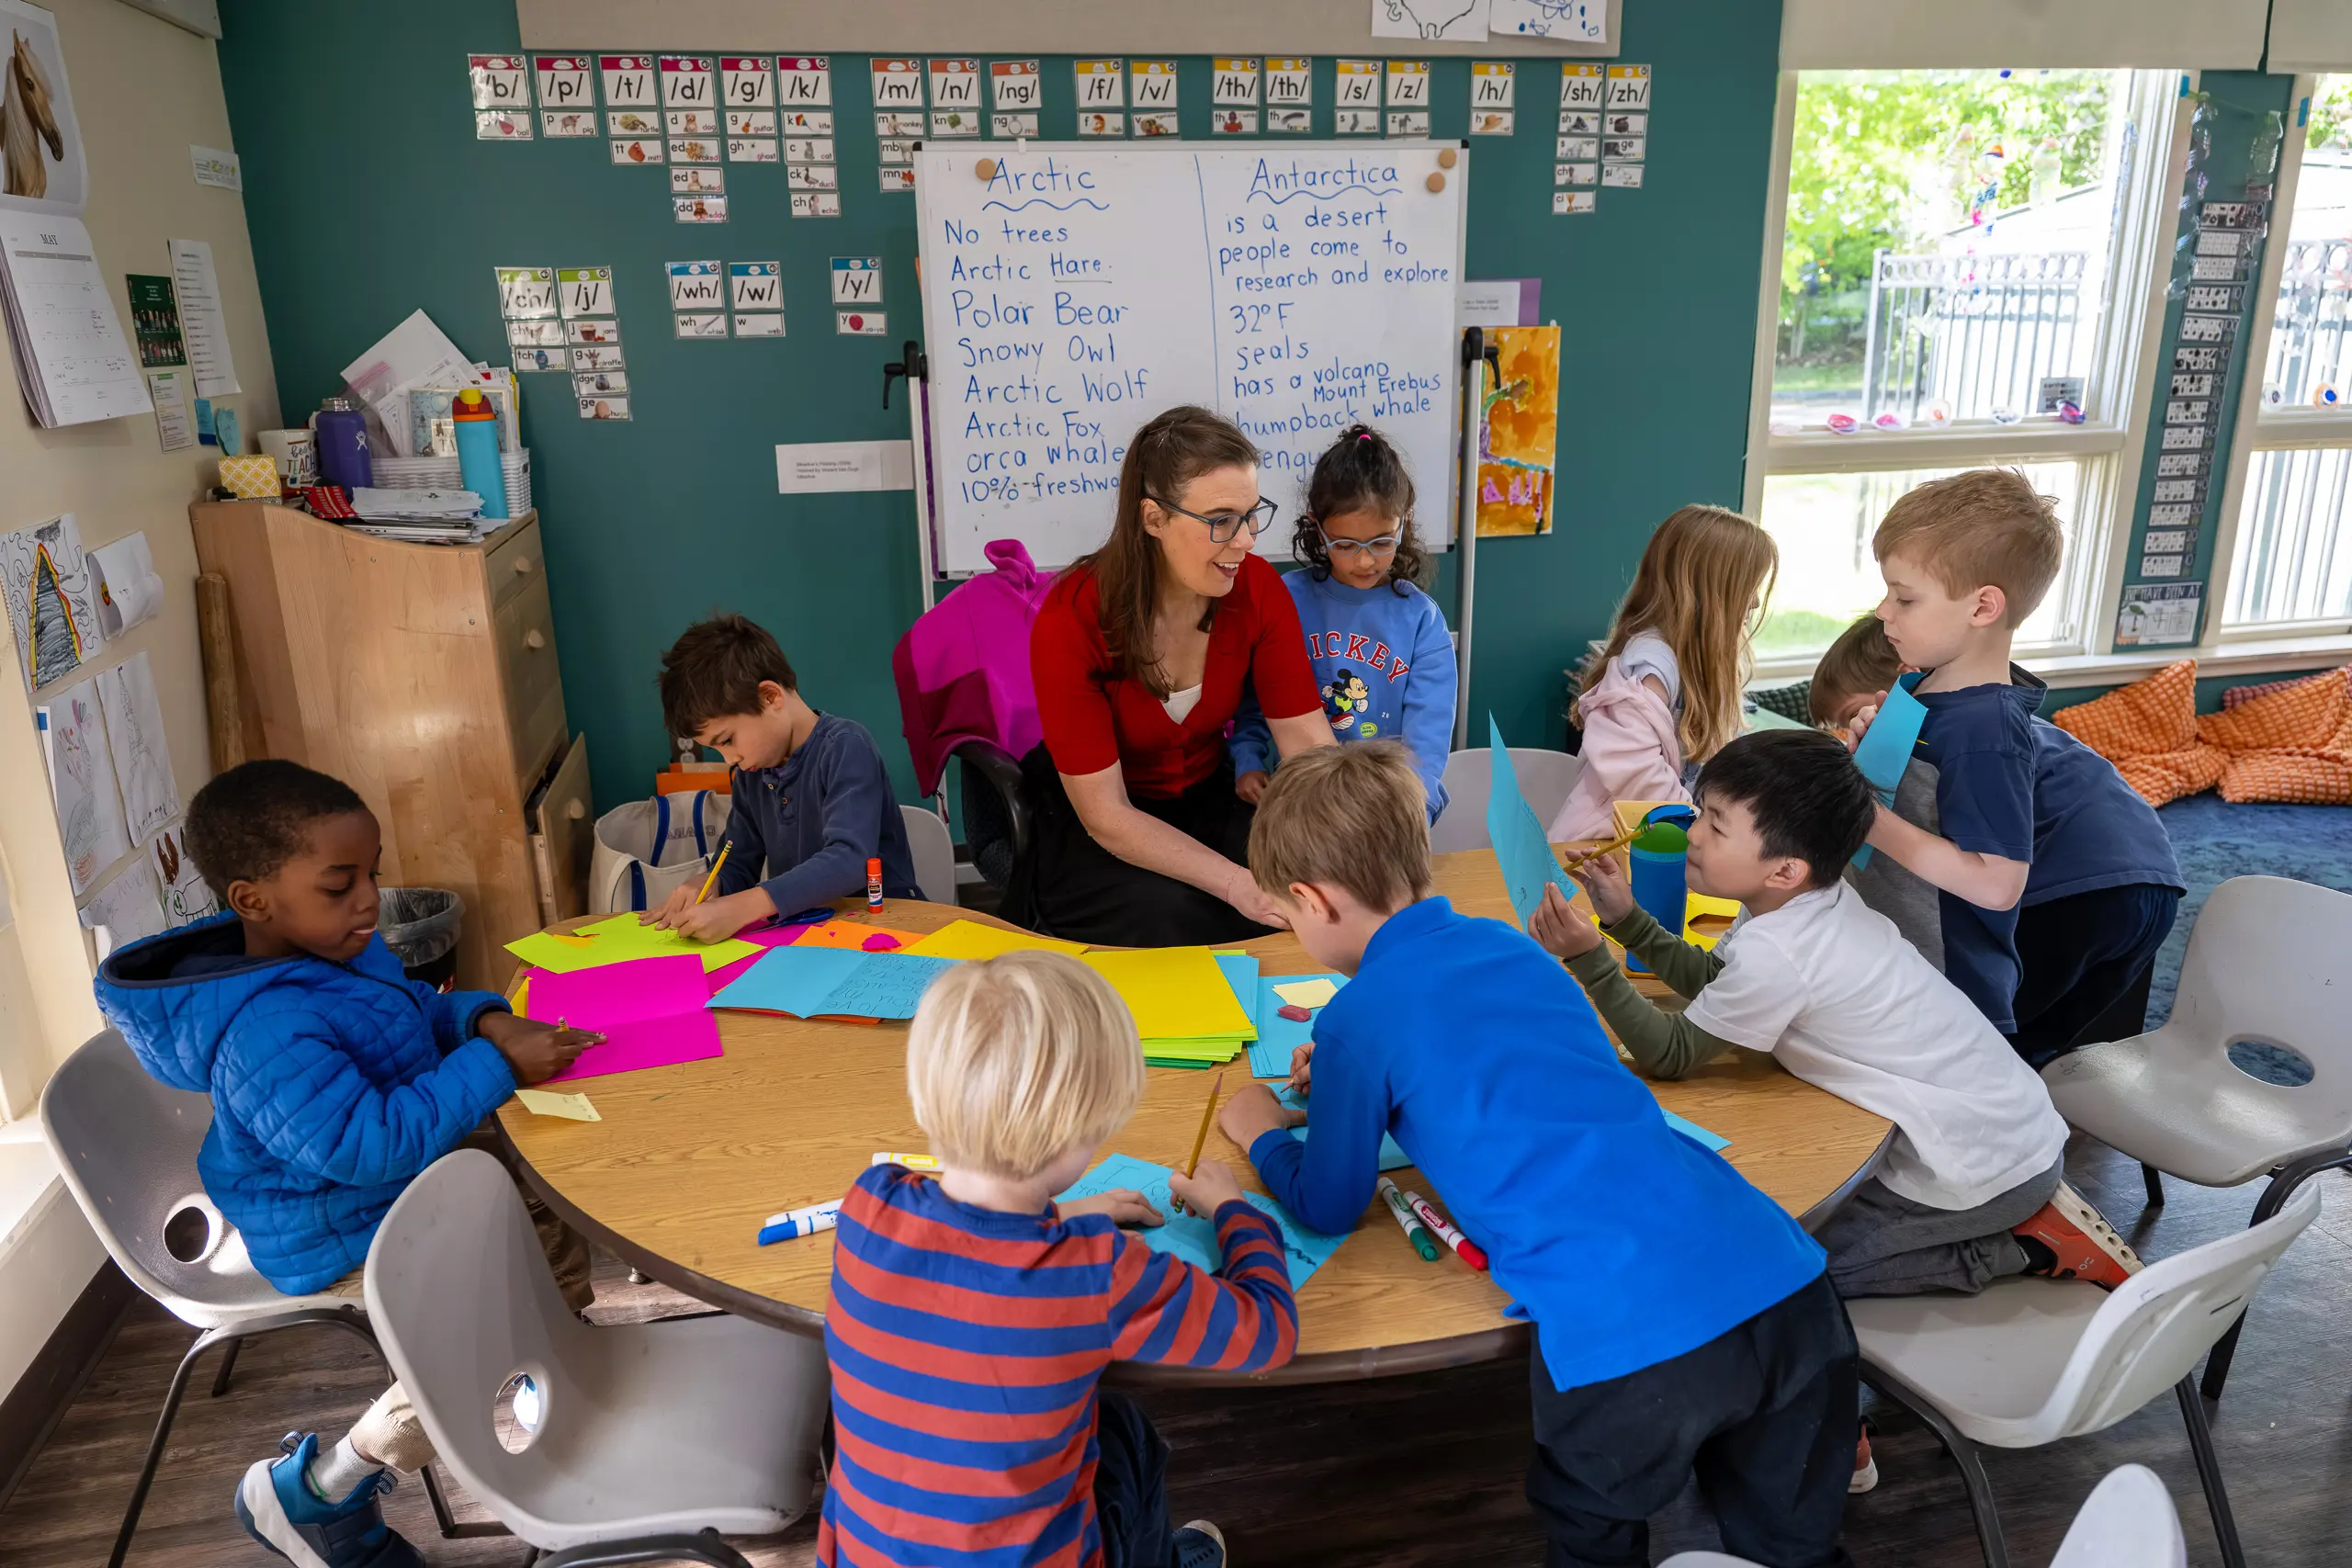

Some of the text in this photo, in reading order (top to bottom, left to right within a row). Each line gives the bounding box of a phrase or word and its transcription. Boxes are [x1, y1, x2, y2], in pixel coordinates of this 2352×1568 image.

[548, 73, 582, 102] /p/
[615, 75, 643, 99] /t/
[671, 77, 705, 101] /d/
[730, 73, 765, 102] /g/
[789, 75, 820, 99] /k/
[879, 77, 918, 99] /m/
[940, 77, 972, 101] /n/
[999, 79, 1036, 103] /ng/
[1088, 77, 1114, 101] /f/
[1140, 78, 1170, 101] /v/
[1216, 74, 1256, 98] /th/
[1269, 75, 1308, 97] /th/
[1344, 78, 1372, 101] /s/
[1395, 78, 1423, 99] /z/
[1478, 79, 1508, 101] /h/
[1562, 80, 1602, 102] /sh/
[1607, 82, 1647, 102] /zh/
[547, 115, 554, 125] p
[671, 115, 678, 125] d
[703, 124, 717, 133] dog
[730, 114, 738, 125] g
[788, 115, 794, 125] k
[934, 114, 947, 125] kn
[994, 117, 1007, 127] ng
[615, 144, 625, 154] tt
[671, 141, 685, 152] ed
[730, 141, 744, 153] gh
[882, 141, 899, 152] mb
[674, 172, 688, 182] ed
[790, 169, 802, 179] ck
[883, 170, 900, 178] mn
[988, 157, 1095, 194] Arctic
[1250, 158, 1398, 191] Antarctica
[678, 202, 694, 212] dd
[793, 196, 807, 207] ch
[706, 212, 725, 220] teddy
[1227, 201, 1387, 233] is a desert
[40, 233, 59, 246] MAY
[944, 219, 1069, 244] No trees
[1219, 230, 1408, 276] people come to
[951, 254, 1031, 281] Arctic
[1236, 260, 1449, 292] research and explore
[676, 280, 718, 300] /wh/
[738, 279, 775, 302] /w/
[842, 272, 872, 299] /y/
[575, 283, 599, 311] /j/
[952, 289, 1129, 328] Polar Bear
[680, 317, 696, 327] wh
[737, 317, 747, 326] w
[517, 351, 534, 360] tch
[576, 350, 583, 361] g
[957, 333, 1115, 375] Snowy Owl
[1236, 334, 1309, 371] seals
[578, 374, 595, 384] dge
[964, 367, 1149, 403] Arctic Wolf
[1234, 356, 1390, 399] has a volcano
[1313, 372, 1442, 412] Mount Erebus
[581, 399, 595, 409] ge
[965, 411, 1106, 439] Arctic Fox
[1235, 389, 1431, 447] humpback whale
[966, 437, 1126, 473] orca whale
[2187, 529, 2199, 543] 20
[1306, 631, 1410, 683] ICKEY
